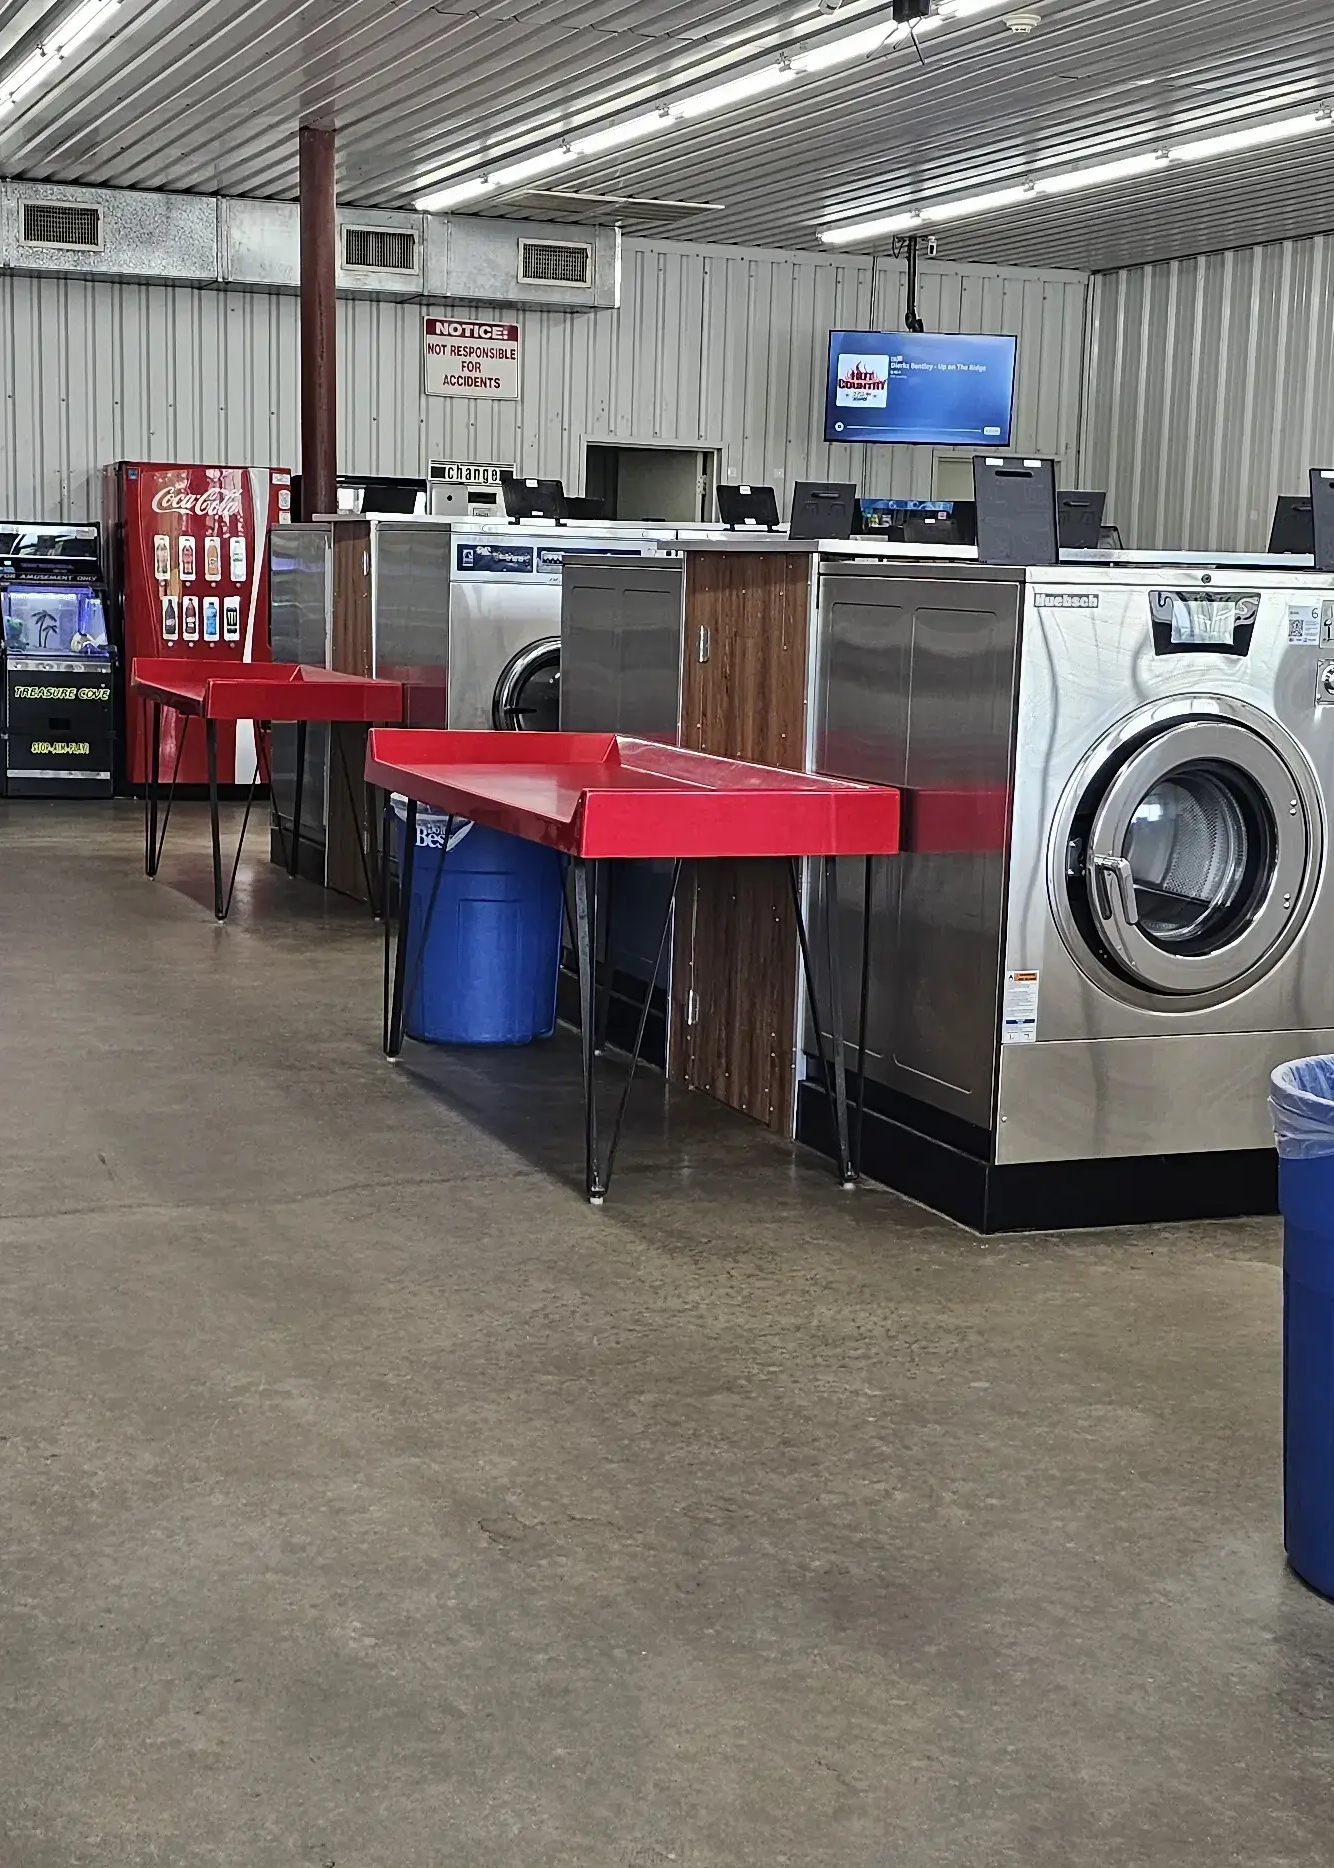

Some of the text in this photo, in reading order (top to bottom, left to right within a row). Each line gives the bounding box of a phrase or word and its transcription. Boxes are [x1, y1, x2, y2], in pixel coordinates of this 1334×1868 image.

[435, 321, 508, 340] NOTICE:
[427, 343, 516, 360] NOT RESPONSIBLE
[461, 361, 482, 373] FOR
[443, 374, 501, 389] ACCIDENTS
[447, 464, 498, 484] change
[151, 486, 243, 515] Coca-Cola
[1035, 594, 1098, 607] Huebsch
[1312, 607, 1319, 619] 6
[14, 686, 110, 700] TREASURE COVE
